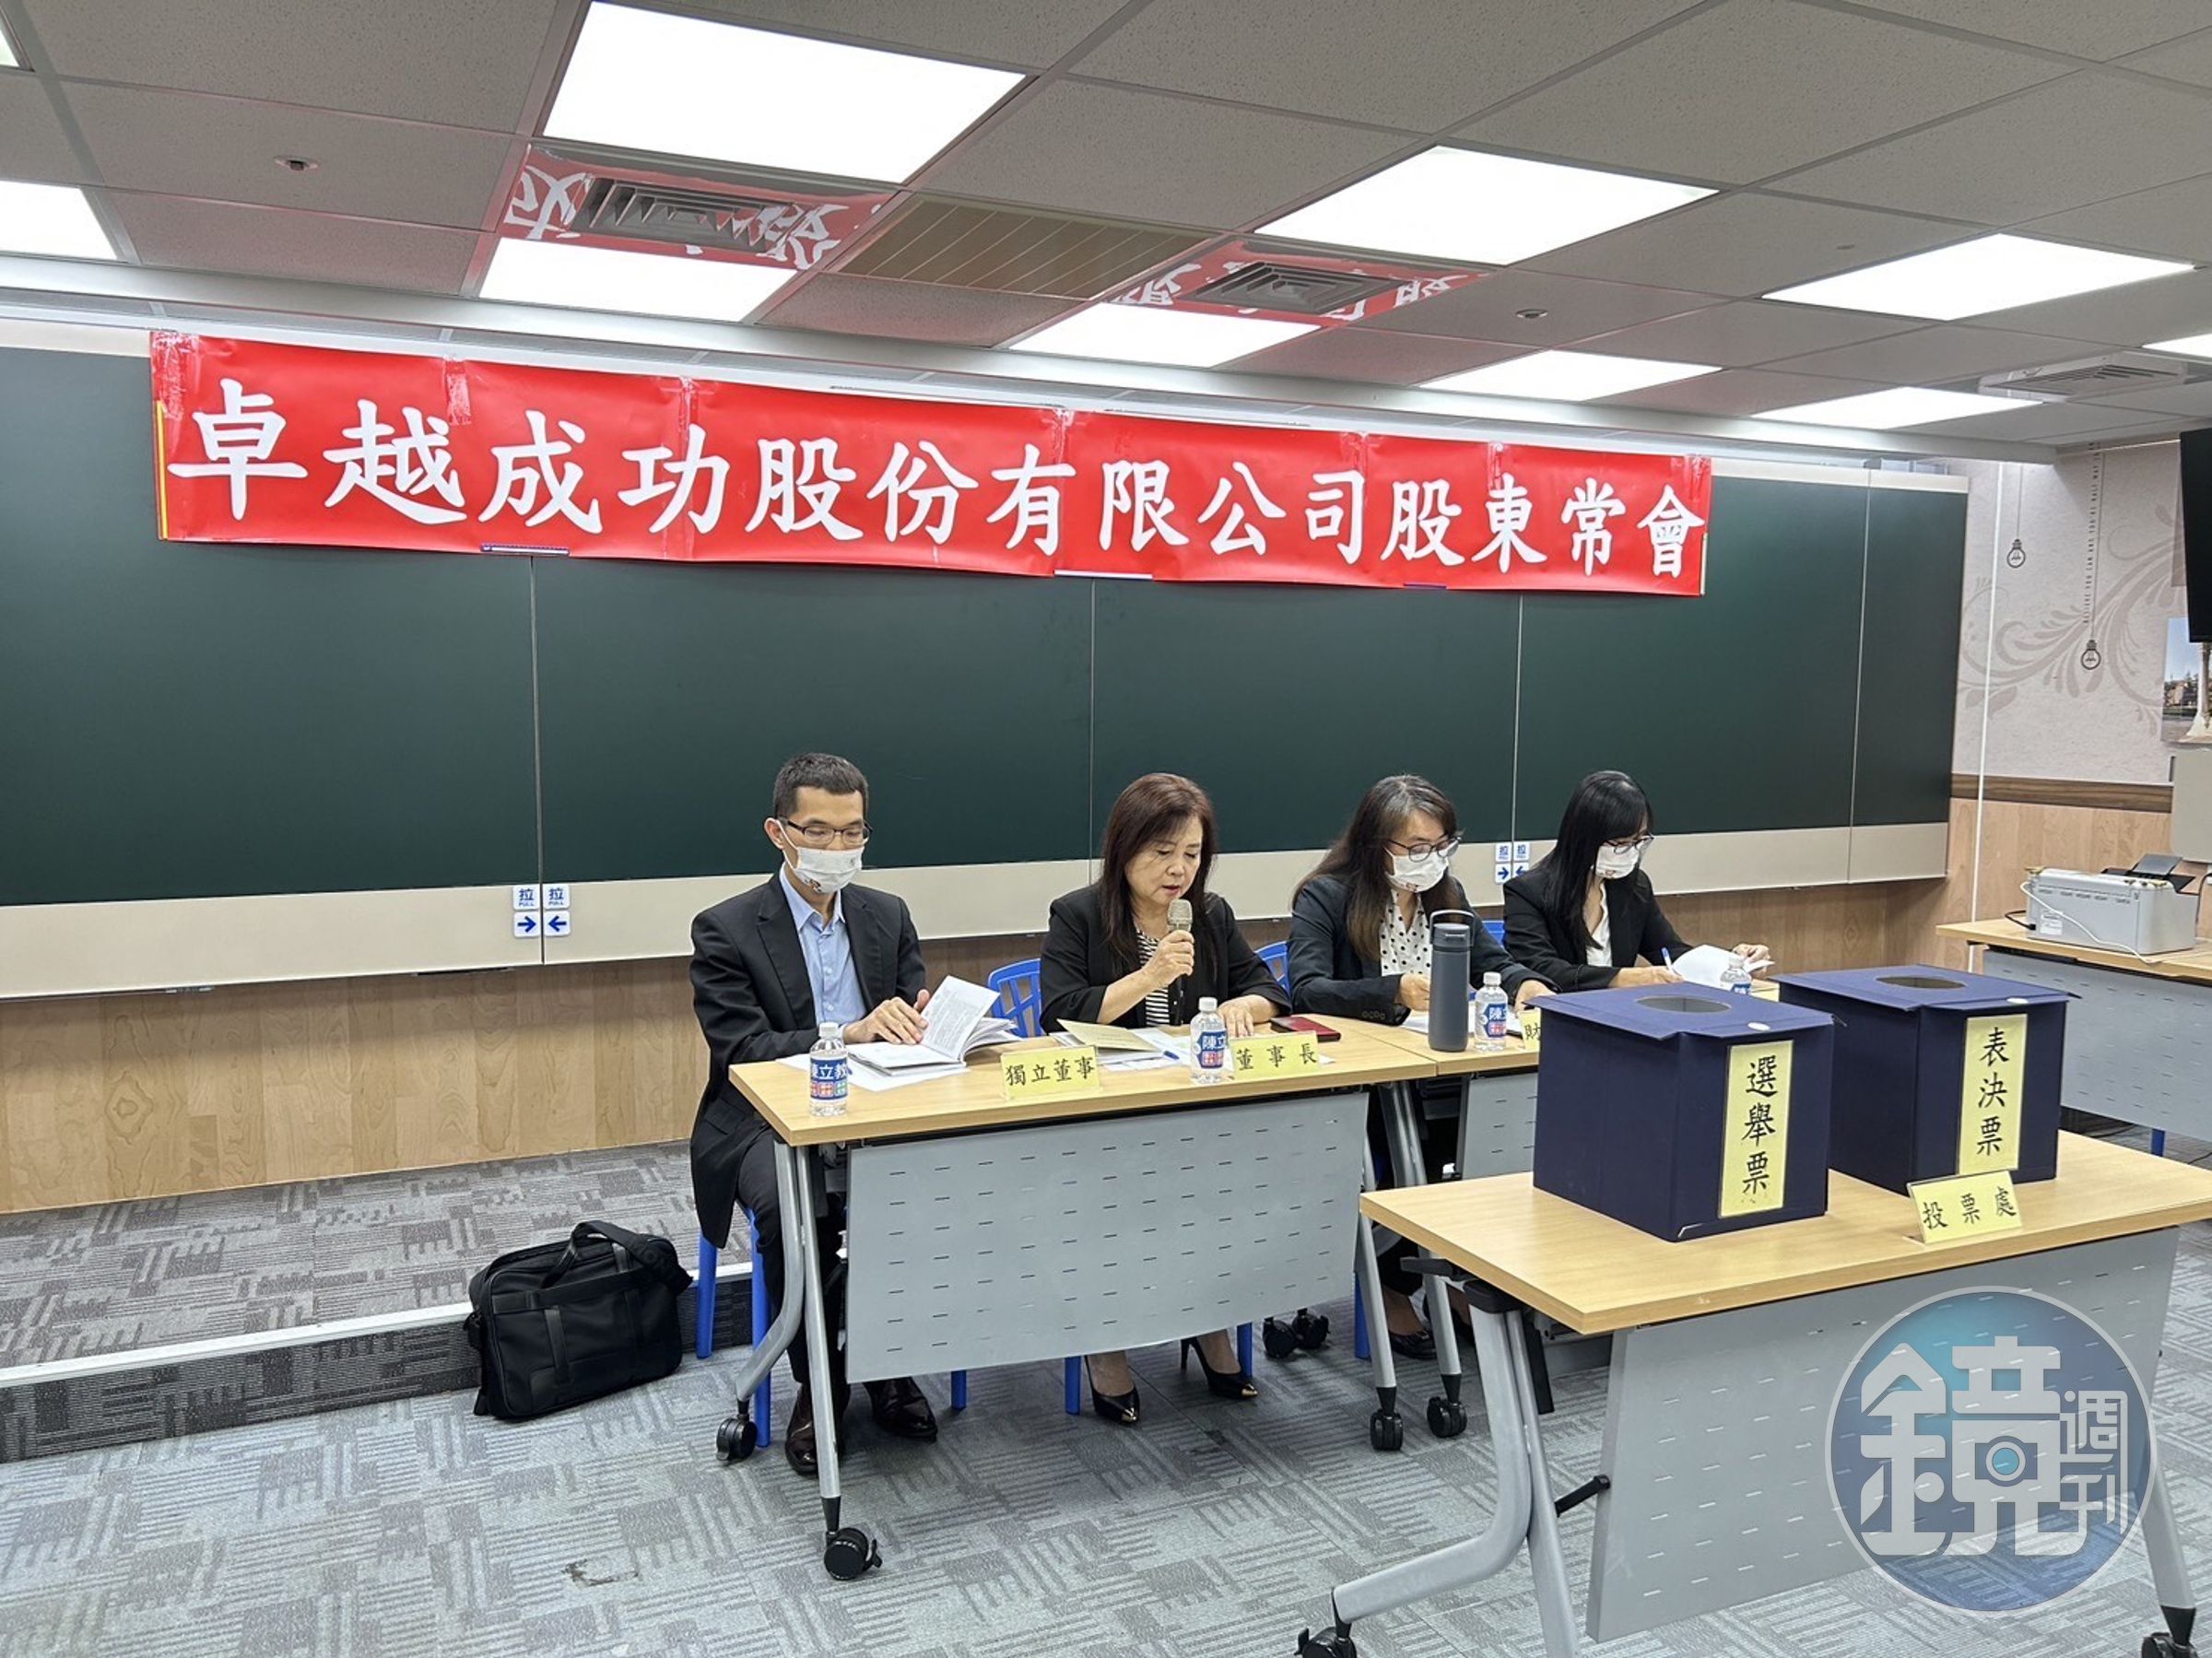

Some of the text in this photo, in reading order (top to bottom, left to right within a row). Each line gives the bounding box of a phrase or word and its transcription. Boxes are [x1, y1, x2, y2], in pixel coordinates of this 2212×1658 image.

[168, 377, 1705, 577] 卓越成功股份有限公司股東常會
[518, 888, 535, 900] 拉
[548, 887, 564, 900] 拉
[1006, 1055, 1095, 1086] 獨立董事
[1236, 1042, 1317, 1071] 董事長
[1976, 1026, 2010, 1157] 表決票
[1741, 1054, 1778, 1195] 選舉票
[1922, 1186, 2017, 1230] 投票處
